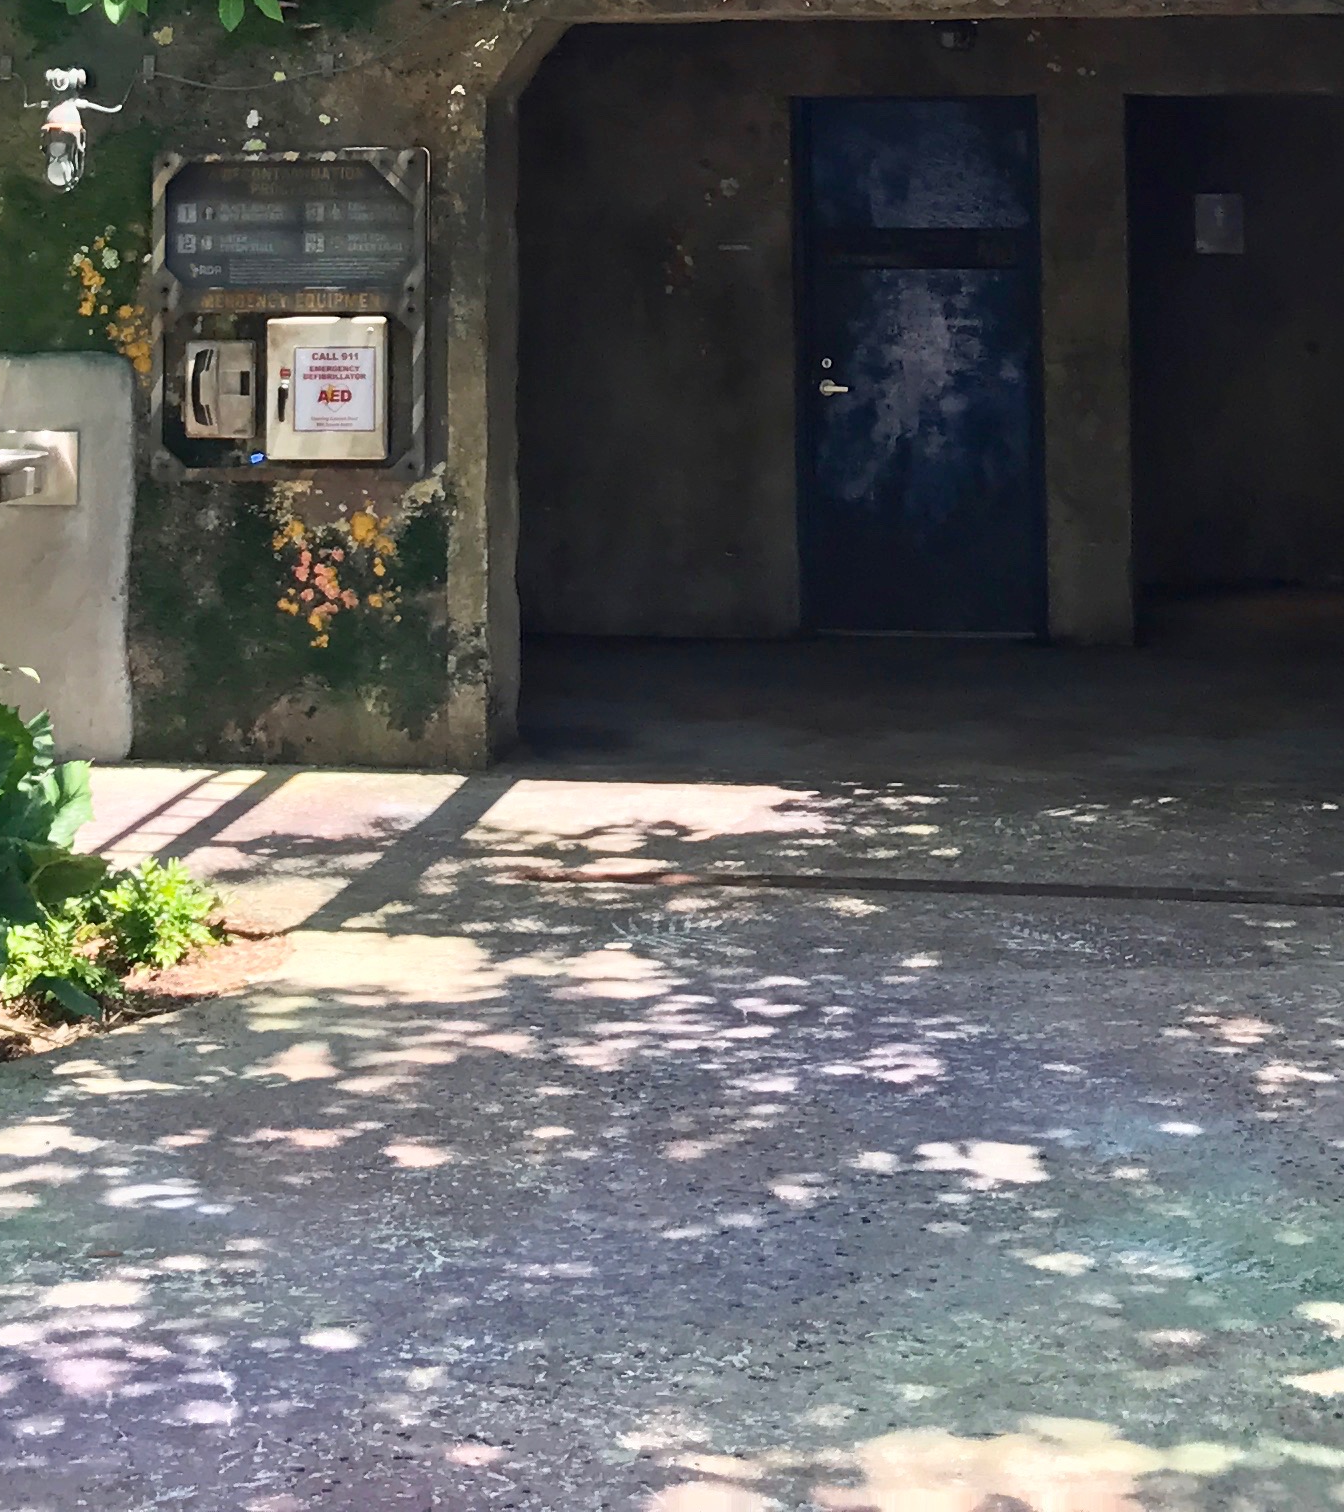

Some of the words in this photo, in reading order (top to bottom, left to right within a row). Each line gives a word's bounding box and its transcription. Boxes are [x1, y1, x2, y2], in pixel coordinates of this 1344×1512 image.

[311, 352, 338, 361] CALL
[341, 352, 359, 361] 911
[317, 389, 353, 403] AED
